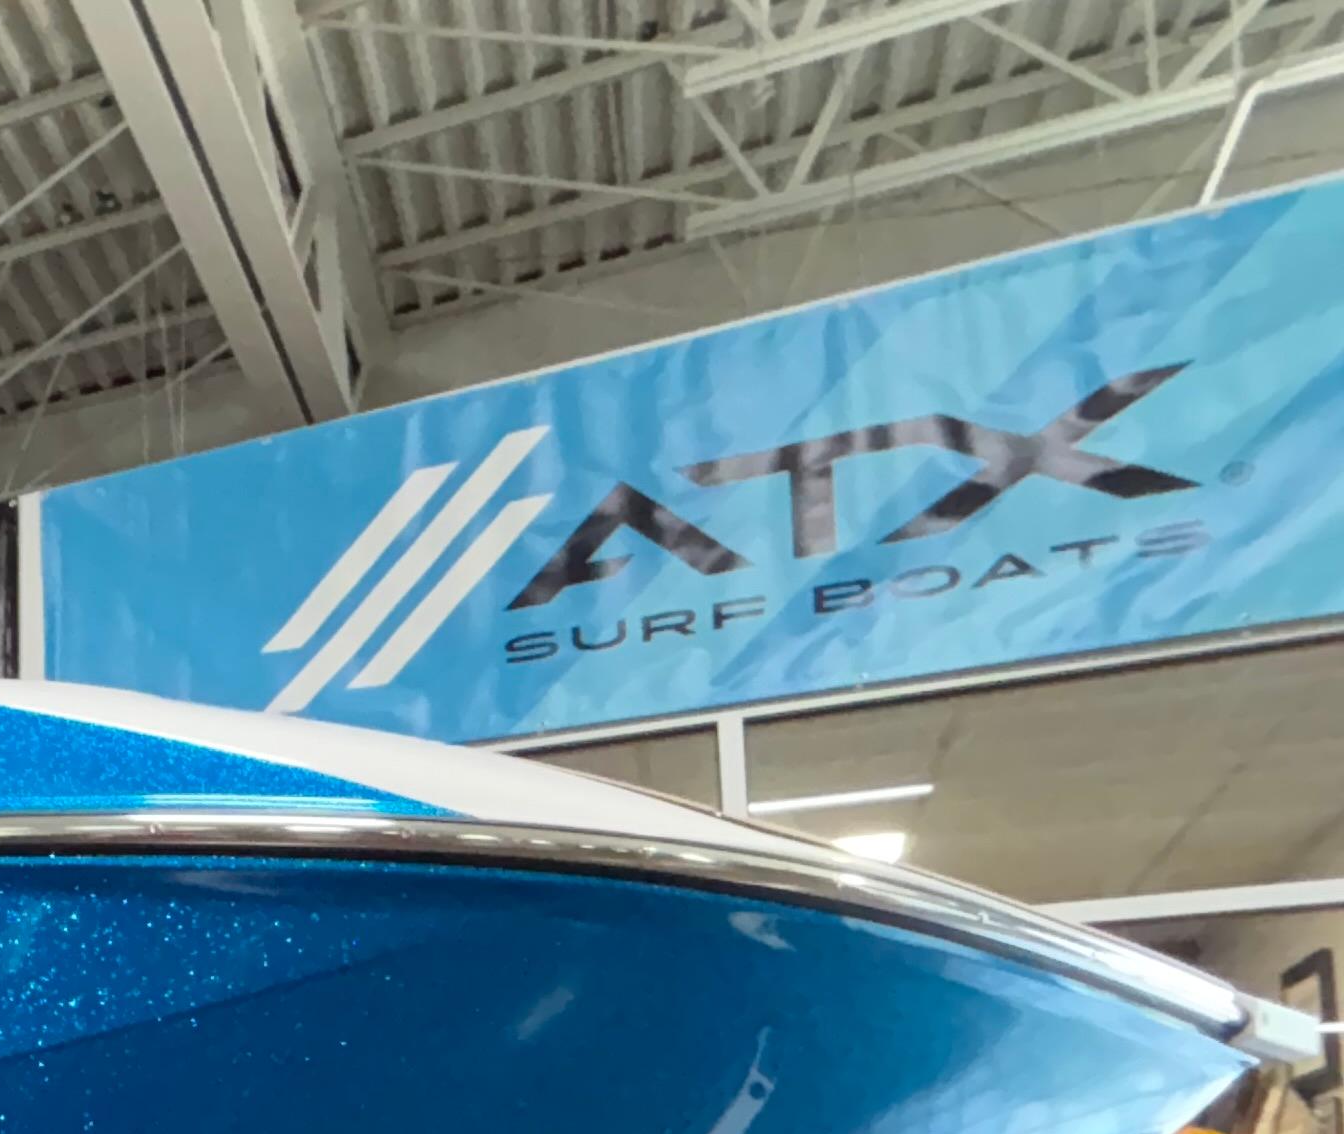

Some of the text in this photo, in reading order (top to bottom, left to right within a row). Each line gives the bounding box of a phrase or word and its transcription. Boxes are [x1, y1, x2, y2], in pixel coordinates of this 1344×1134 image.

[505, 359, 1203, 610] ATX
[504, 518, 1211, 664] SURF BOATS
